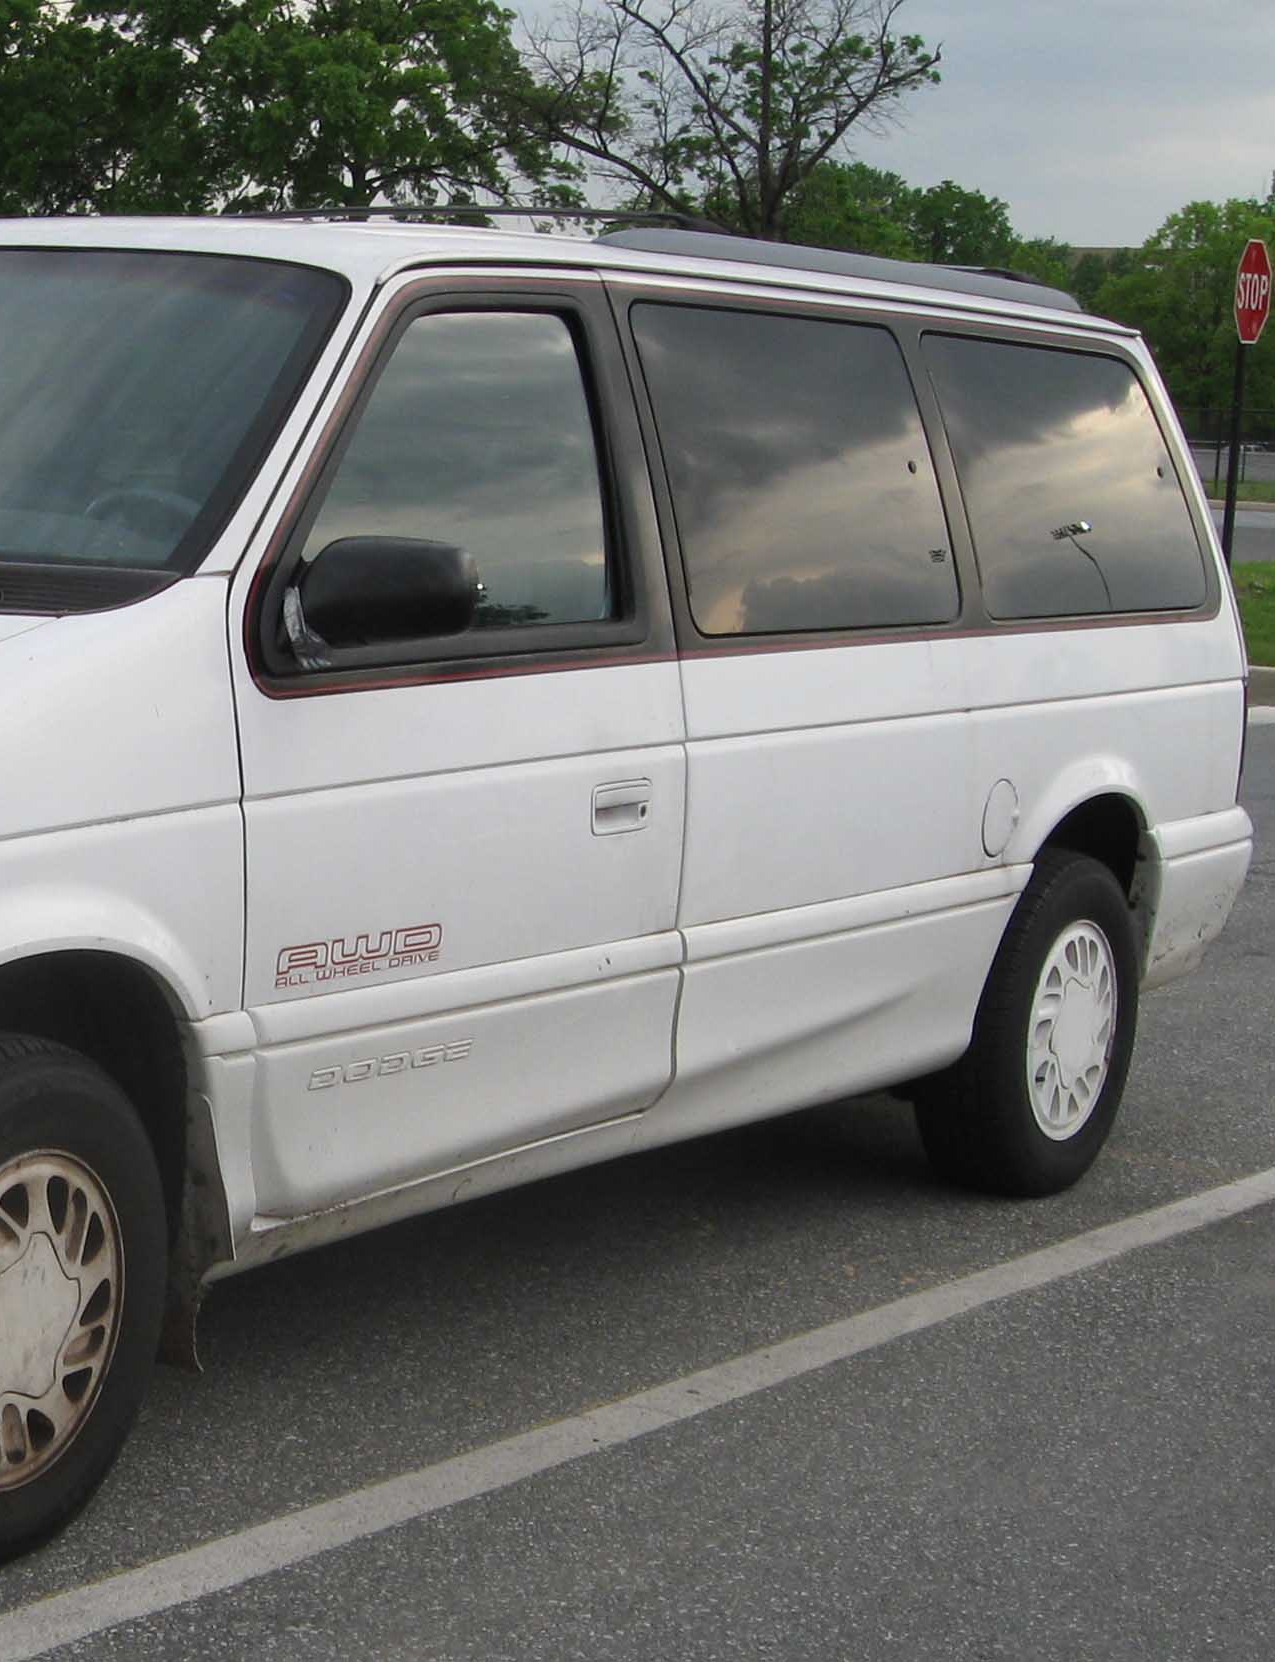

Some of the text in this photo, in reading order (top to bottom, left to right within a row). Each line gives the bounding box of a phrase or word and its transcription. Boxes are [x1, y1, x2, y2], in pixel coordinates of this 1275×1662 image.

[1237, 272, 1269, 310] STOP
[275, 950, 440, 988] ALL WHEEL DRIVE
[276, 923, 443, 976] AWD
[307, 1039, 474, 1091] DODGE
